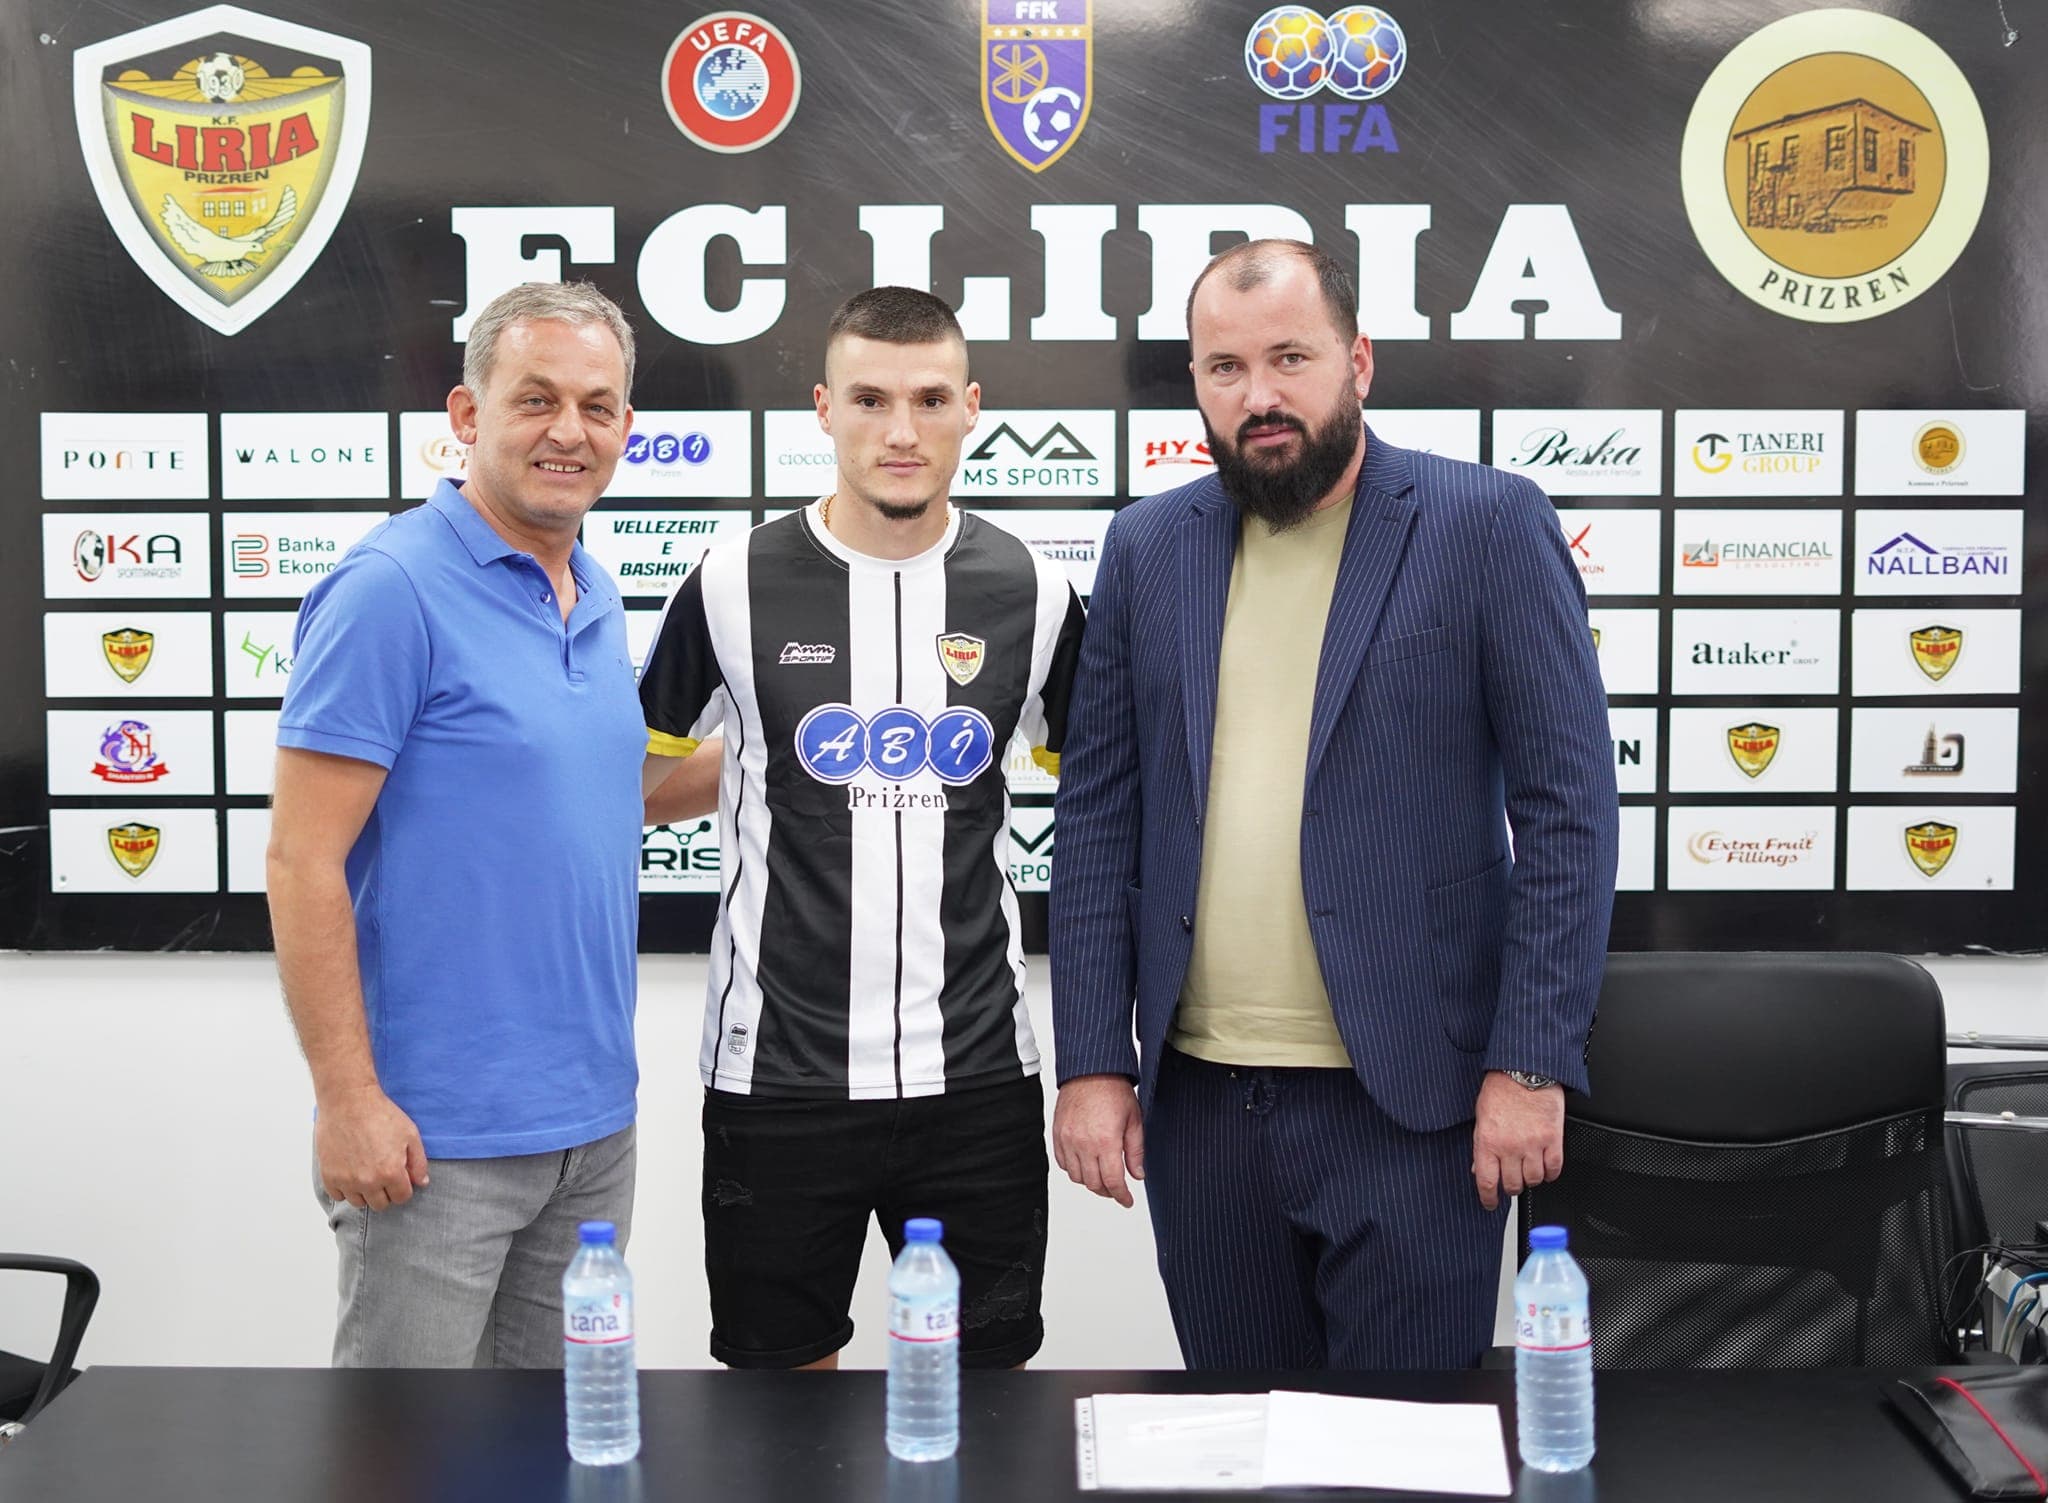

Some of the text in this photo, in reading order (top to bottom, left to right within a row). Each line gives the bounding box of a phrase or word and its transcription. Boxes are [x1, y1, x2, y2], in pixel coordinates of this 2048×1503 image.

[1015, 1, 1058, 19] FFK
[690, 22, 768, 53] UEFA
[1259, 104, 1400, 153] FIFA
[131, 112, 319, 172] LIRIA
[184, 170, 269, 184] PRIZREN
[451, 203, 787, 344] FC
[1759, 266, 1911, 309] PRIZREN
[1737, 432, 1825, 453] TANERI
[236, 447, 375, 463] WALONE
[1742, 455, 1821, 473] GROUP
[964, 468, 1099, 486] MS SPORTS
[613, 520, 720, 534] VELLEZERIT
[278, 537, 336, 552] Banka
[661, 541, 674, 555] E
[1722, 541, 1833, 559] FINANCIAL
[1042, 547, 1097, 562] sniqi
[619, 562, 693, 576] BASHKI
[1868, 556, 2008, 575] NALLBANI
[946, 647, 978, 660] LIRIA
[1692, 641, 1791, 665] ataker
[851, 787, 945, 808] Prizren
[1708, 838, 1814, 850] Extra Fruit
[1726, 852, 1799, 867] Fillings
[570, 1313, 619, 1332] tana
